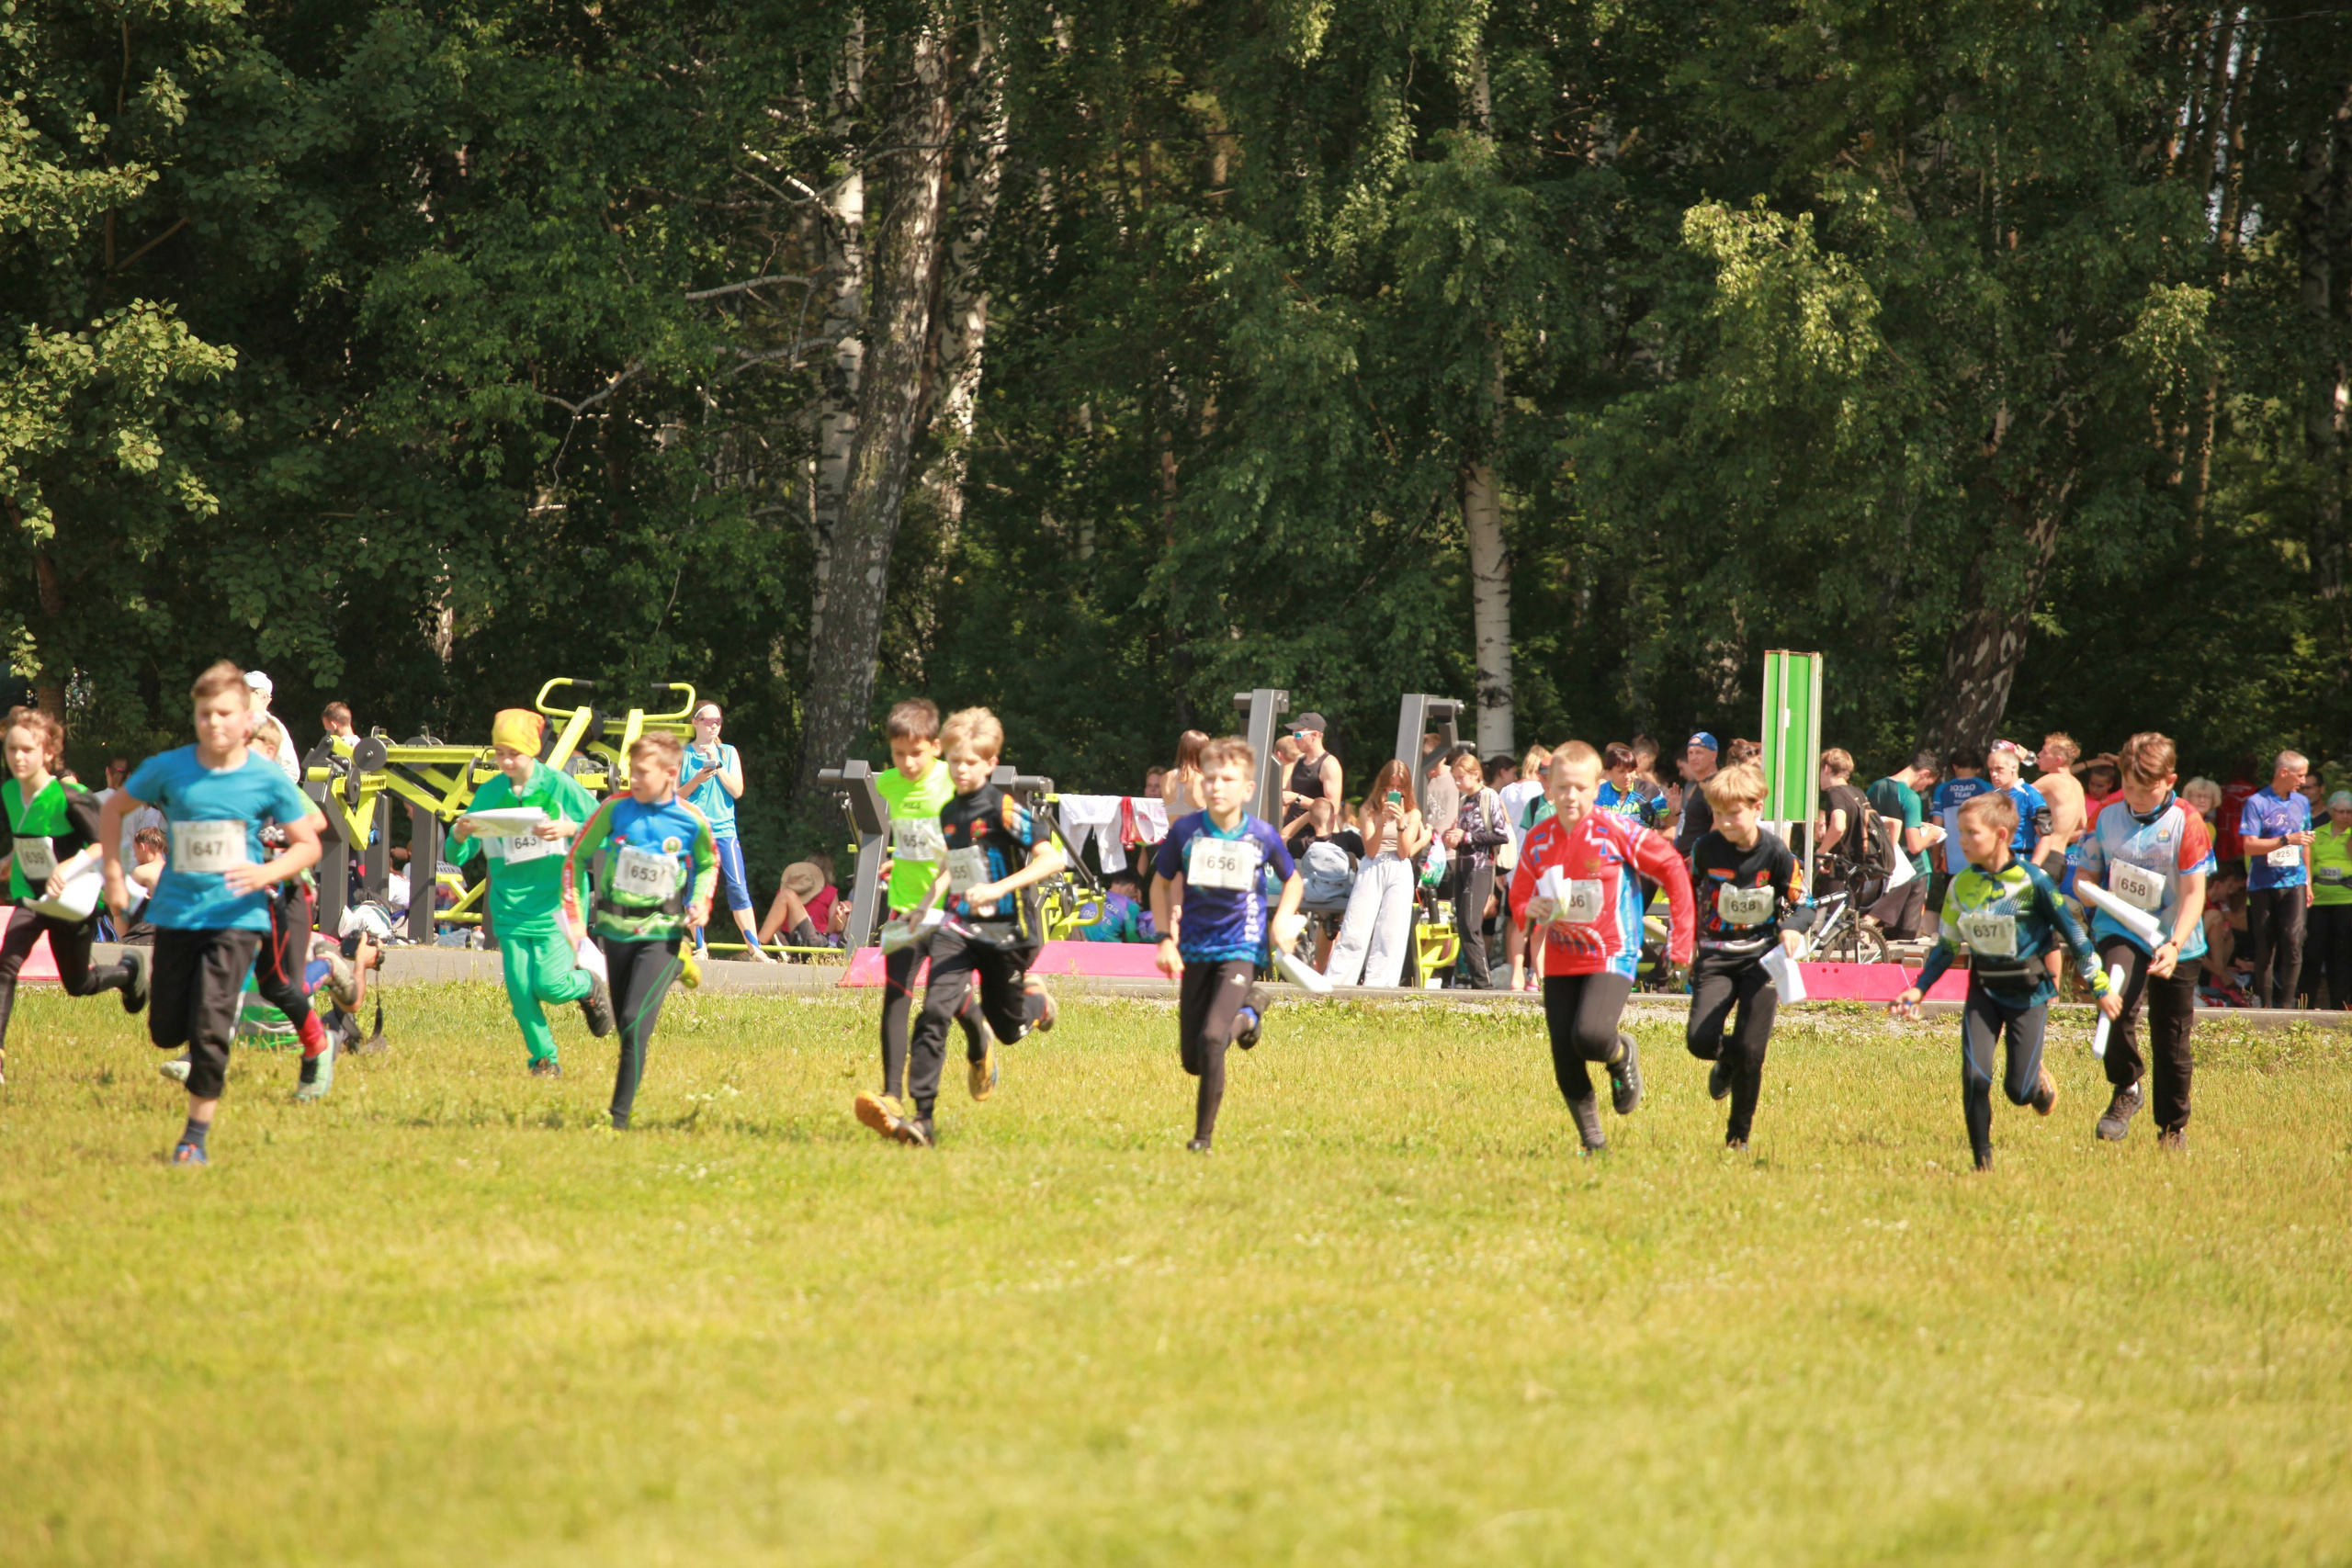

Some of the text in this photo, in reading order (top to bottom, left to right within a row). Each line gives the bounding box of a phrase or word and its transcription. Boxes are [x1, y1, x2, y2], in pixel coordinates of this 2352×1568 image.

[192, 840, 223, 857] 647
[514, 836, 537, 850] 643
[25, 851, 45, 864] 639
[2276, 850, 2290, 859] 825
[1206, 855, 1236, 871] 656
[630, 864, 658, 882] 653
[2120, 877, 2146, 897] 658
[1731, 900, 1757, 913] 638
[1973, 924, 1997, 938] 637
